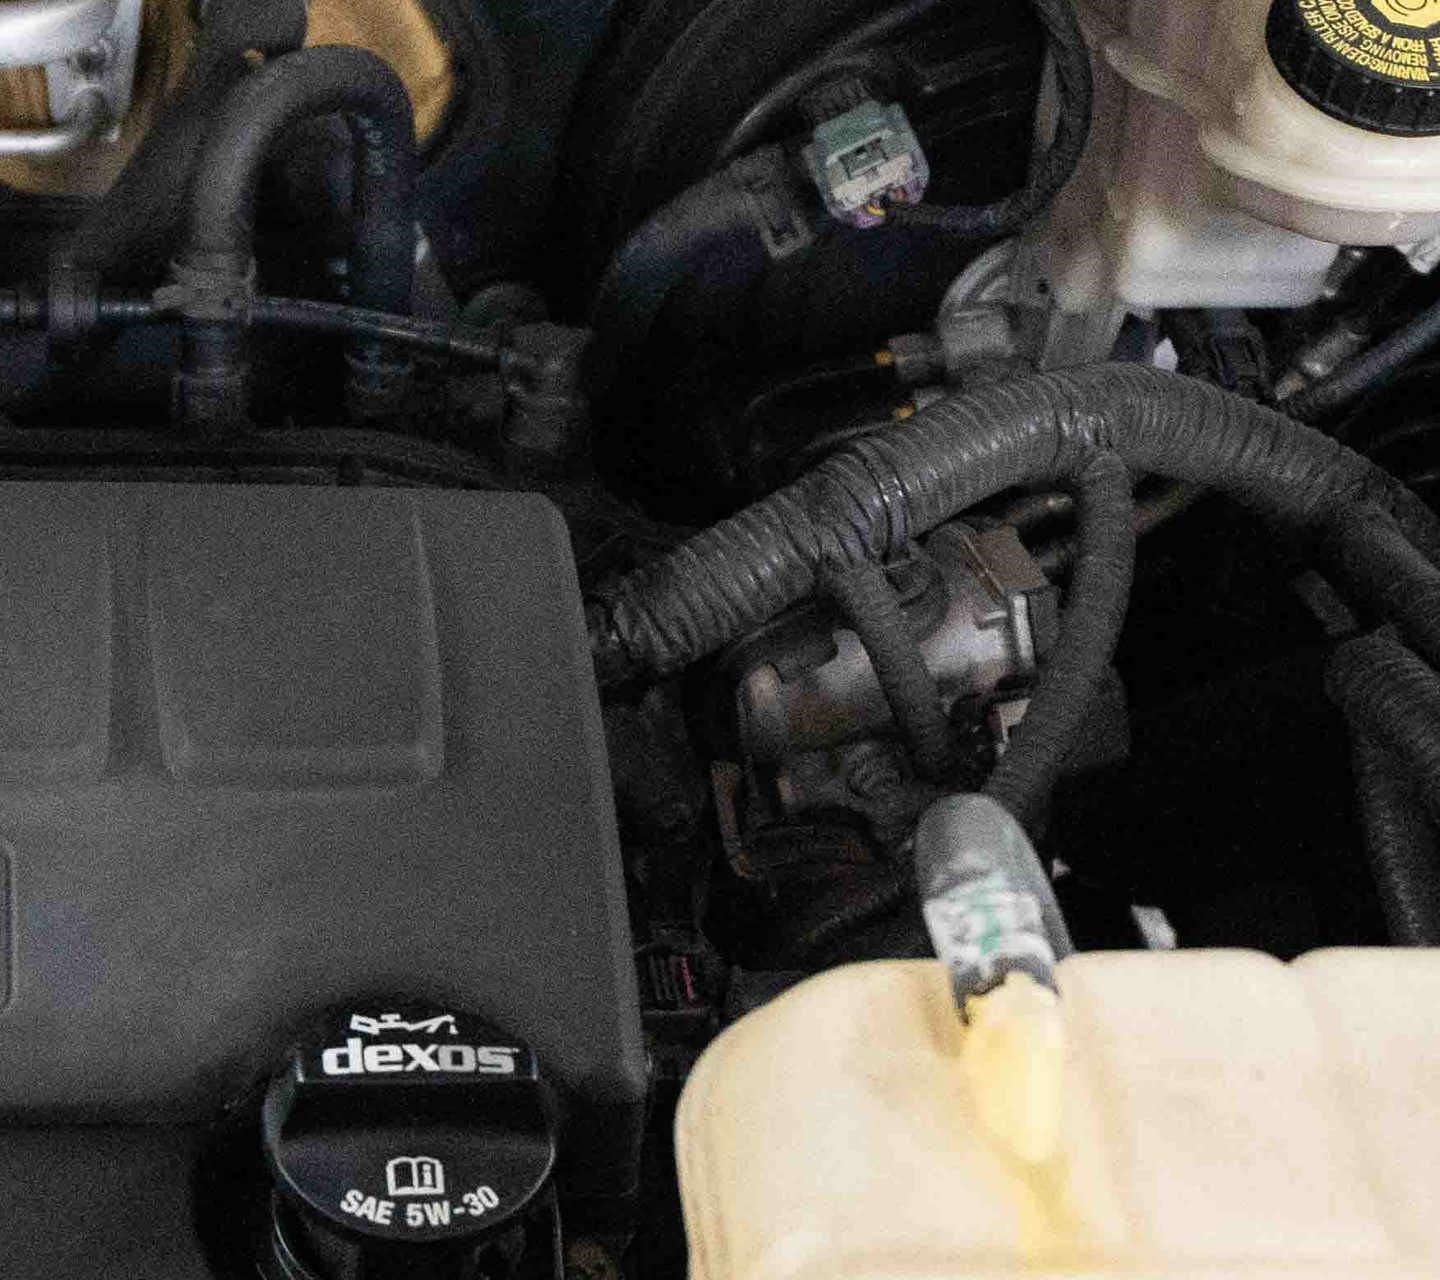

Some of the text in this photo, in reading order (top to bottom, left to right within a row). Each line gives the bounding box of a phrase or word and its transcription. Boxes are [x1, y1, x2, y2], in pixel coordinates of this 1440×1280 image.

[1318, 0, 1345, 22] ONLY
[1342, 8, 1384, 40] SEALED
[1303, 9, 1342, 45] FILLER
[1330, 18, 1362, 42] USE
[1376, 31, 1393, 46] A
[1389, 35, 1429, 53] FROM
[321, 1037, 515, 1075] dexos
[340, 1185, 499, 1226] SAE 5W-30
